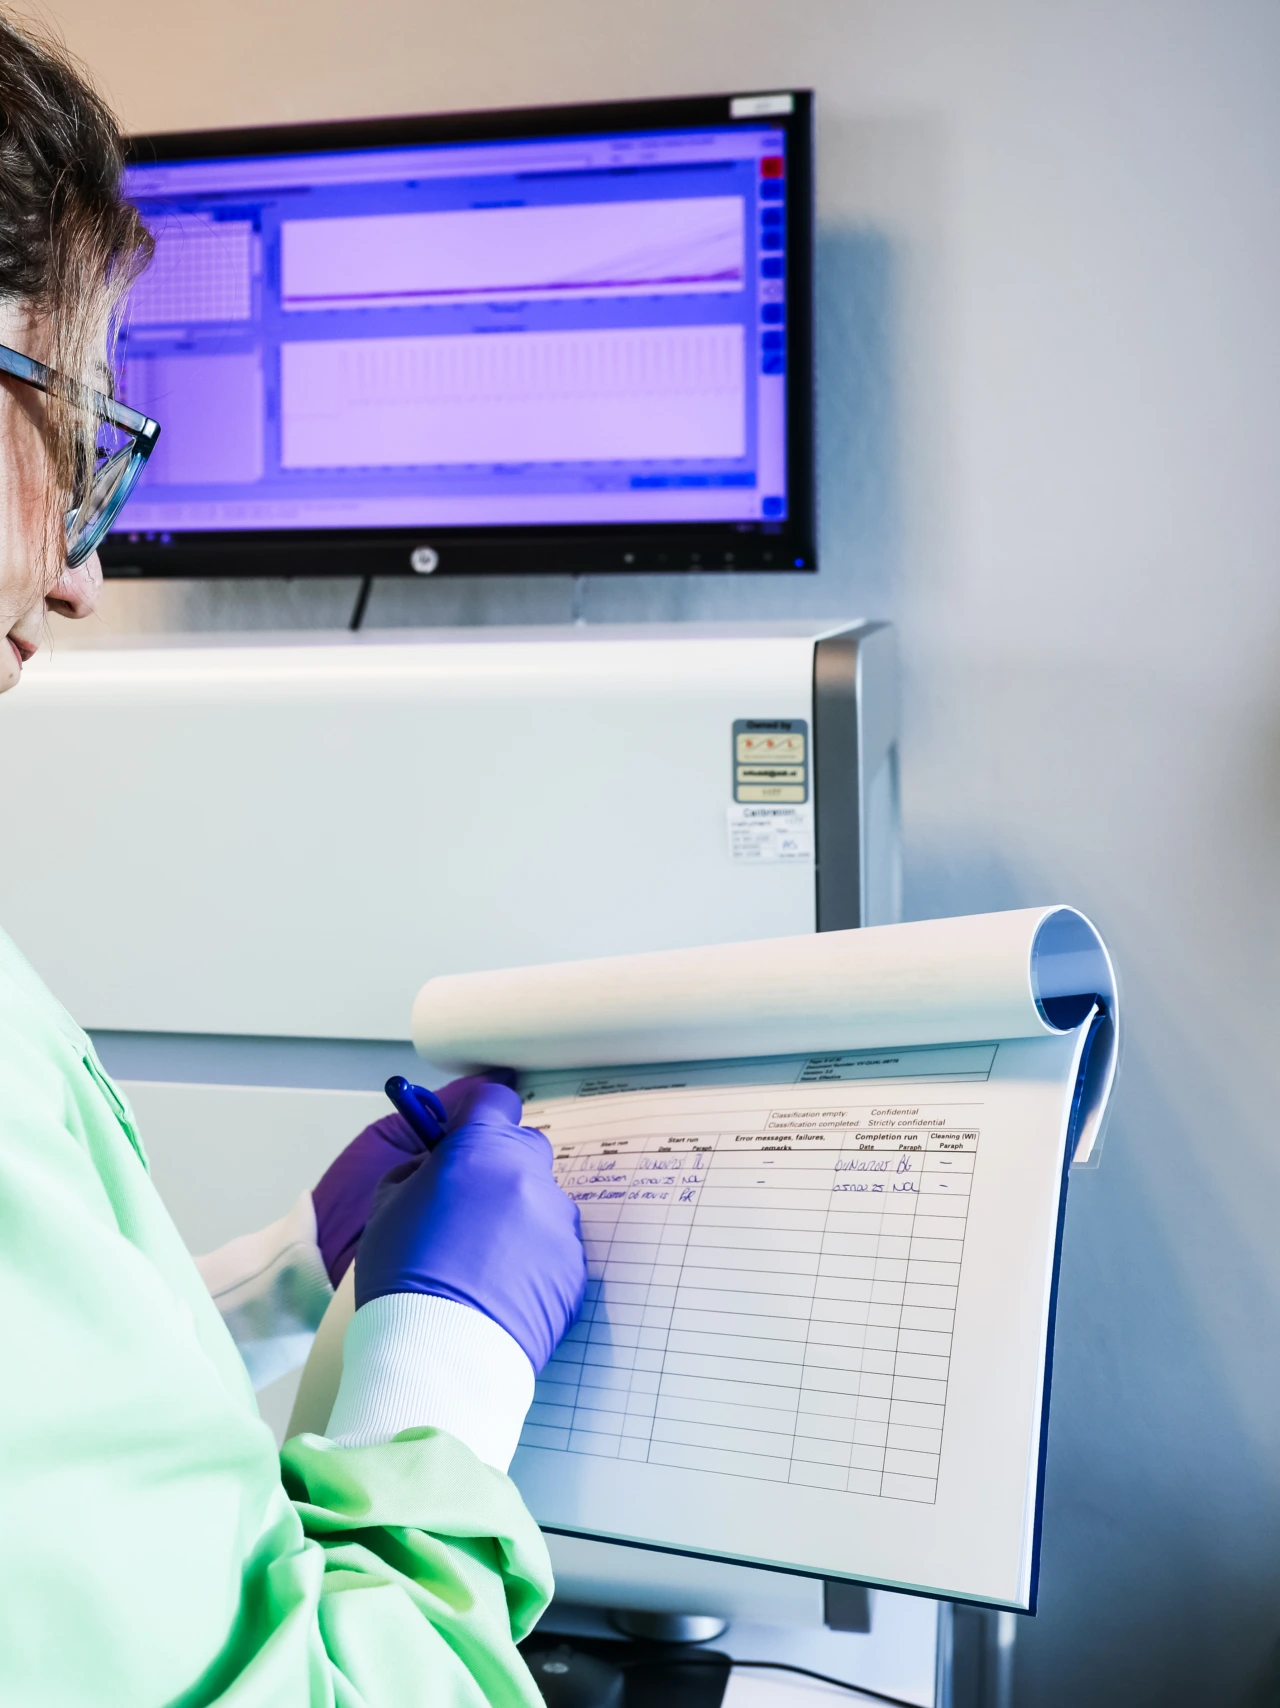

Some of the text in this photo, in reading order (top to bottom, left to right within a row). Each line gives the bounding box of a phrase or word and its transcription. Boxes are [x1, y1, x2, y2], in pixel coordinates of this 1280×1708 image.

[772, 1110, 848, 1119] Classification empty:
[871, 1108, 919, 1116] Confidential
[768, 1119, 861, 1129] Classification completed:
[868, 1118, 946, 1128] Strictly confidential
[755, 1135, 793, 1143] messages,
[795, 1134, 826, 1142] failures,
[855, 1133, 902, 1142] Completion
[939, 1142, 964, 1150] Paraph
